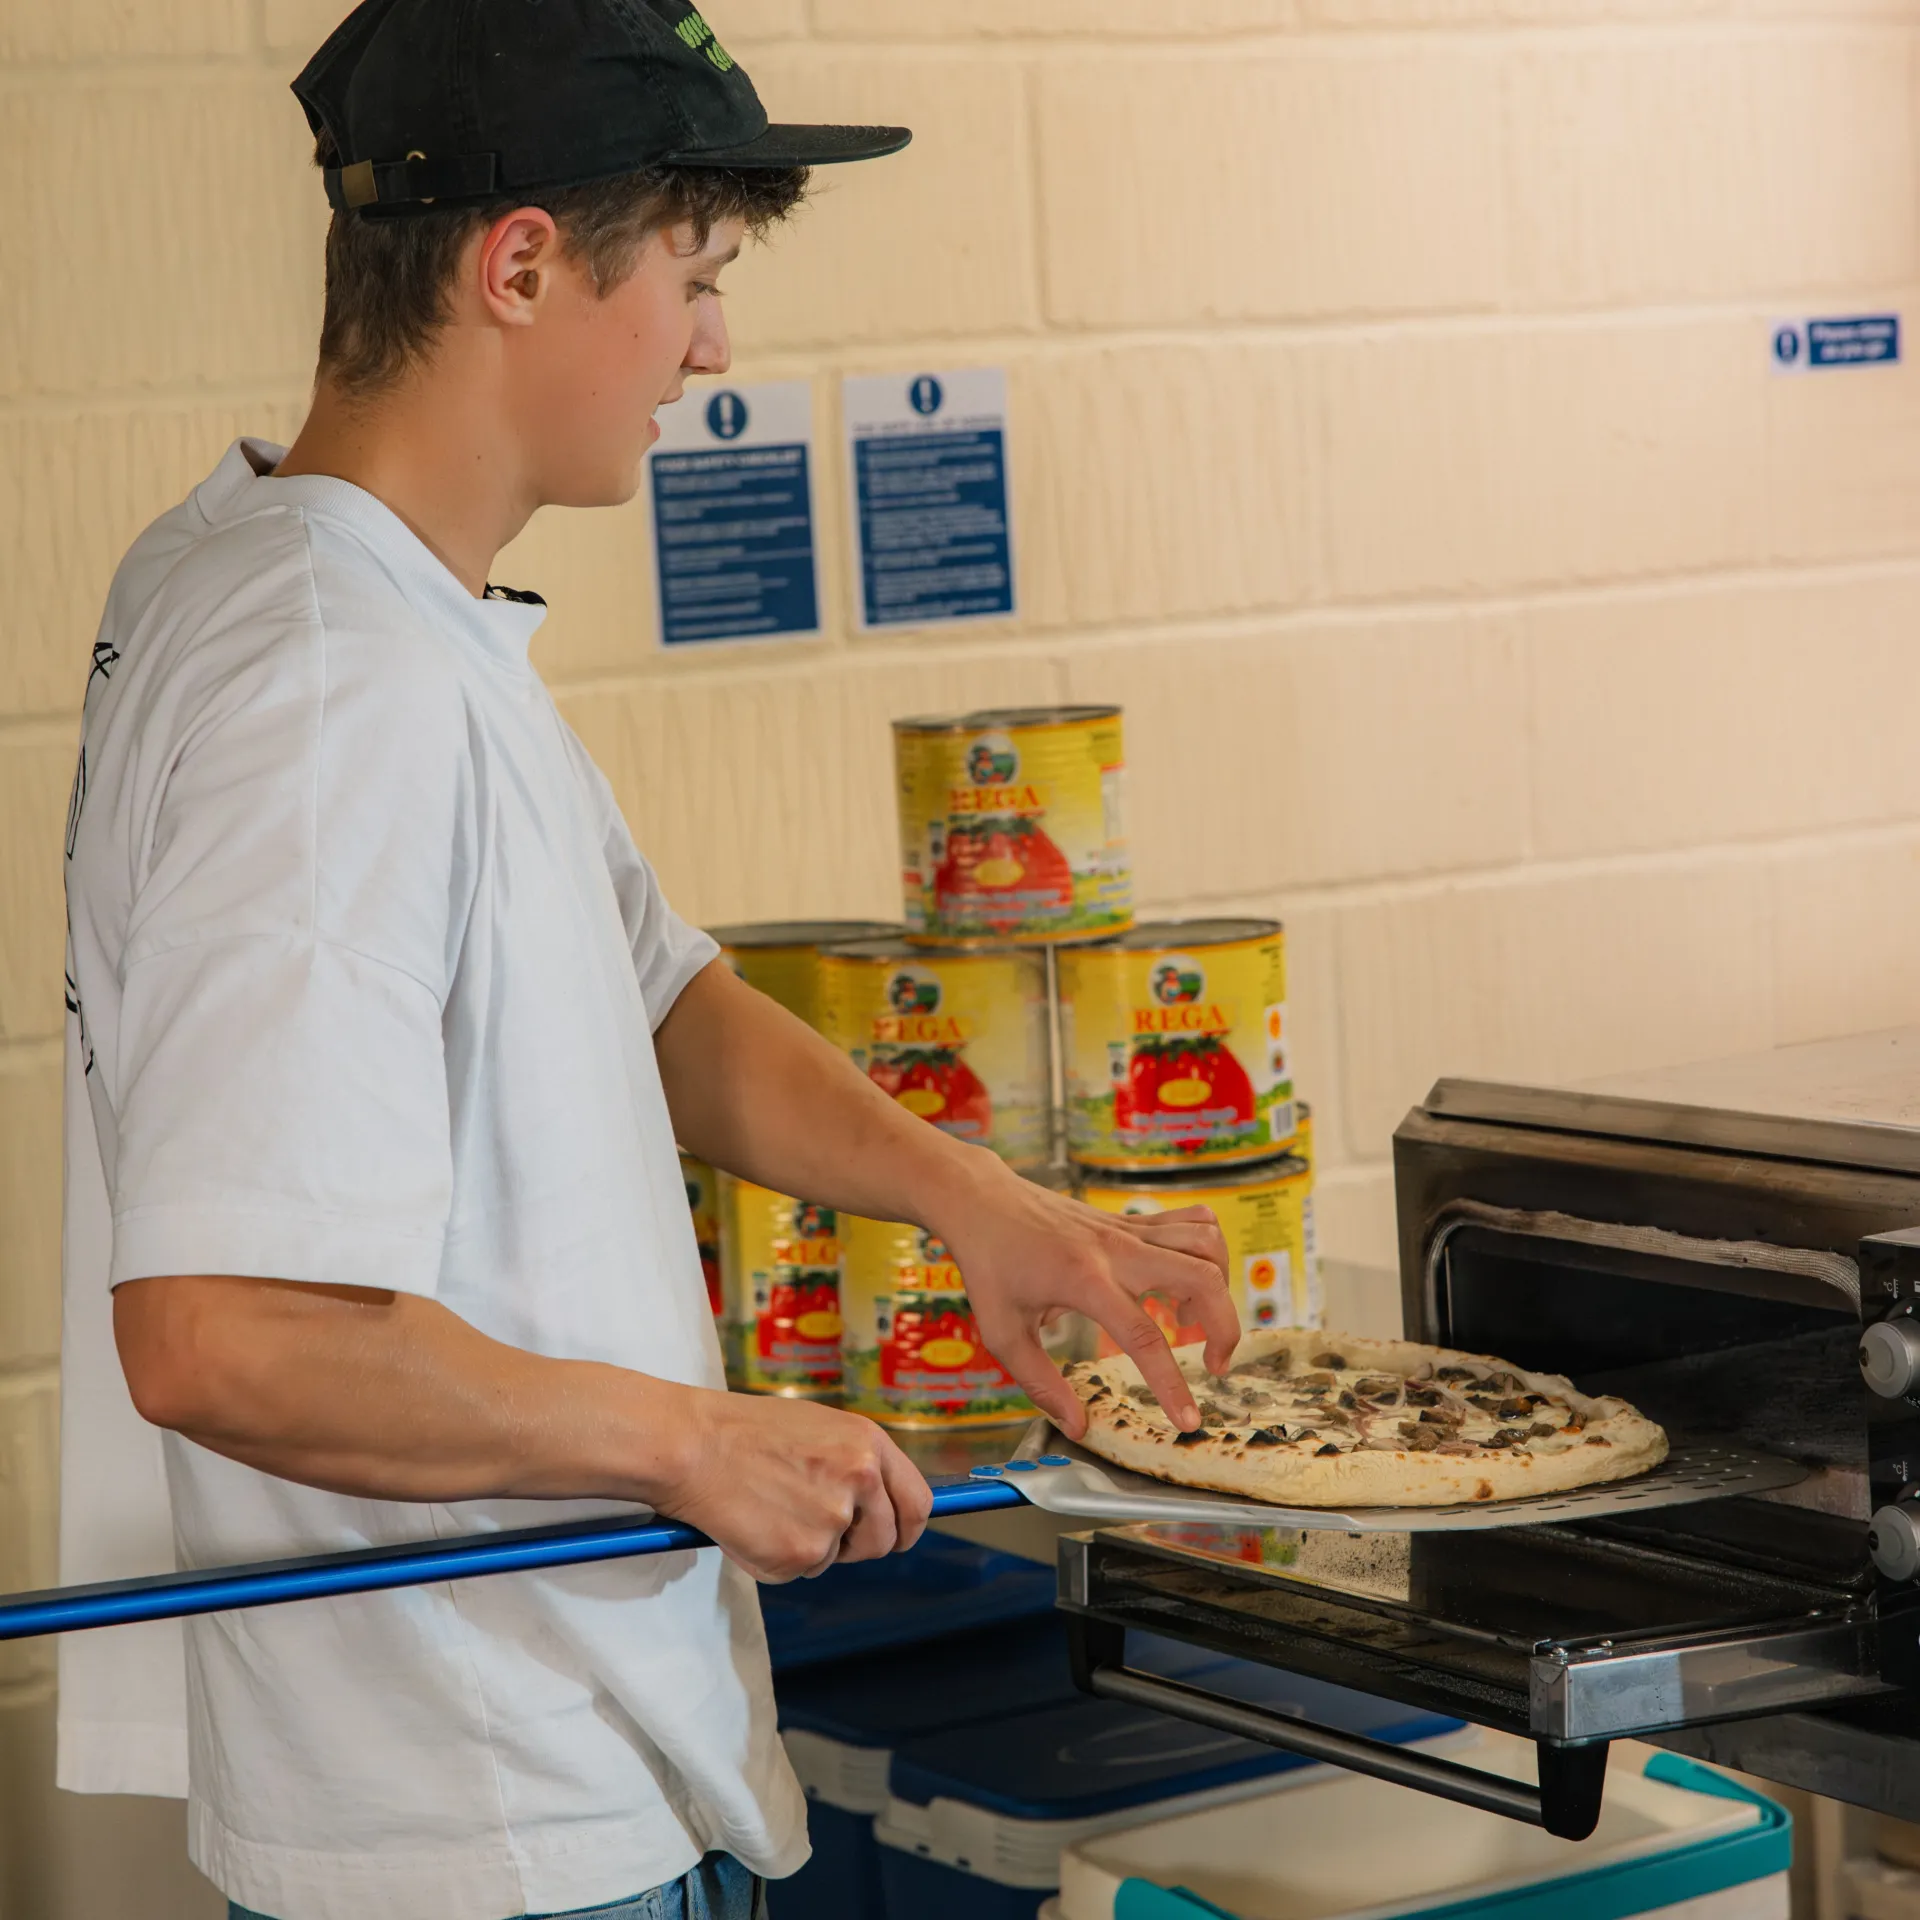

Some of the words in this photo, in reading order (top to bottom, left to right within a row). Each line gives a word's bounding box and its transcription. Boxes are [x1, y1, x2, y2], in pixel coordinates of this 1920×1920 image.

[1134, 1004, 1226, 1033] REGA
[776, 1240, 840, 1265] REG
[899, 1264, 964, 1290] REG
